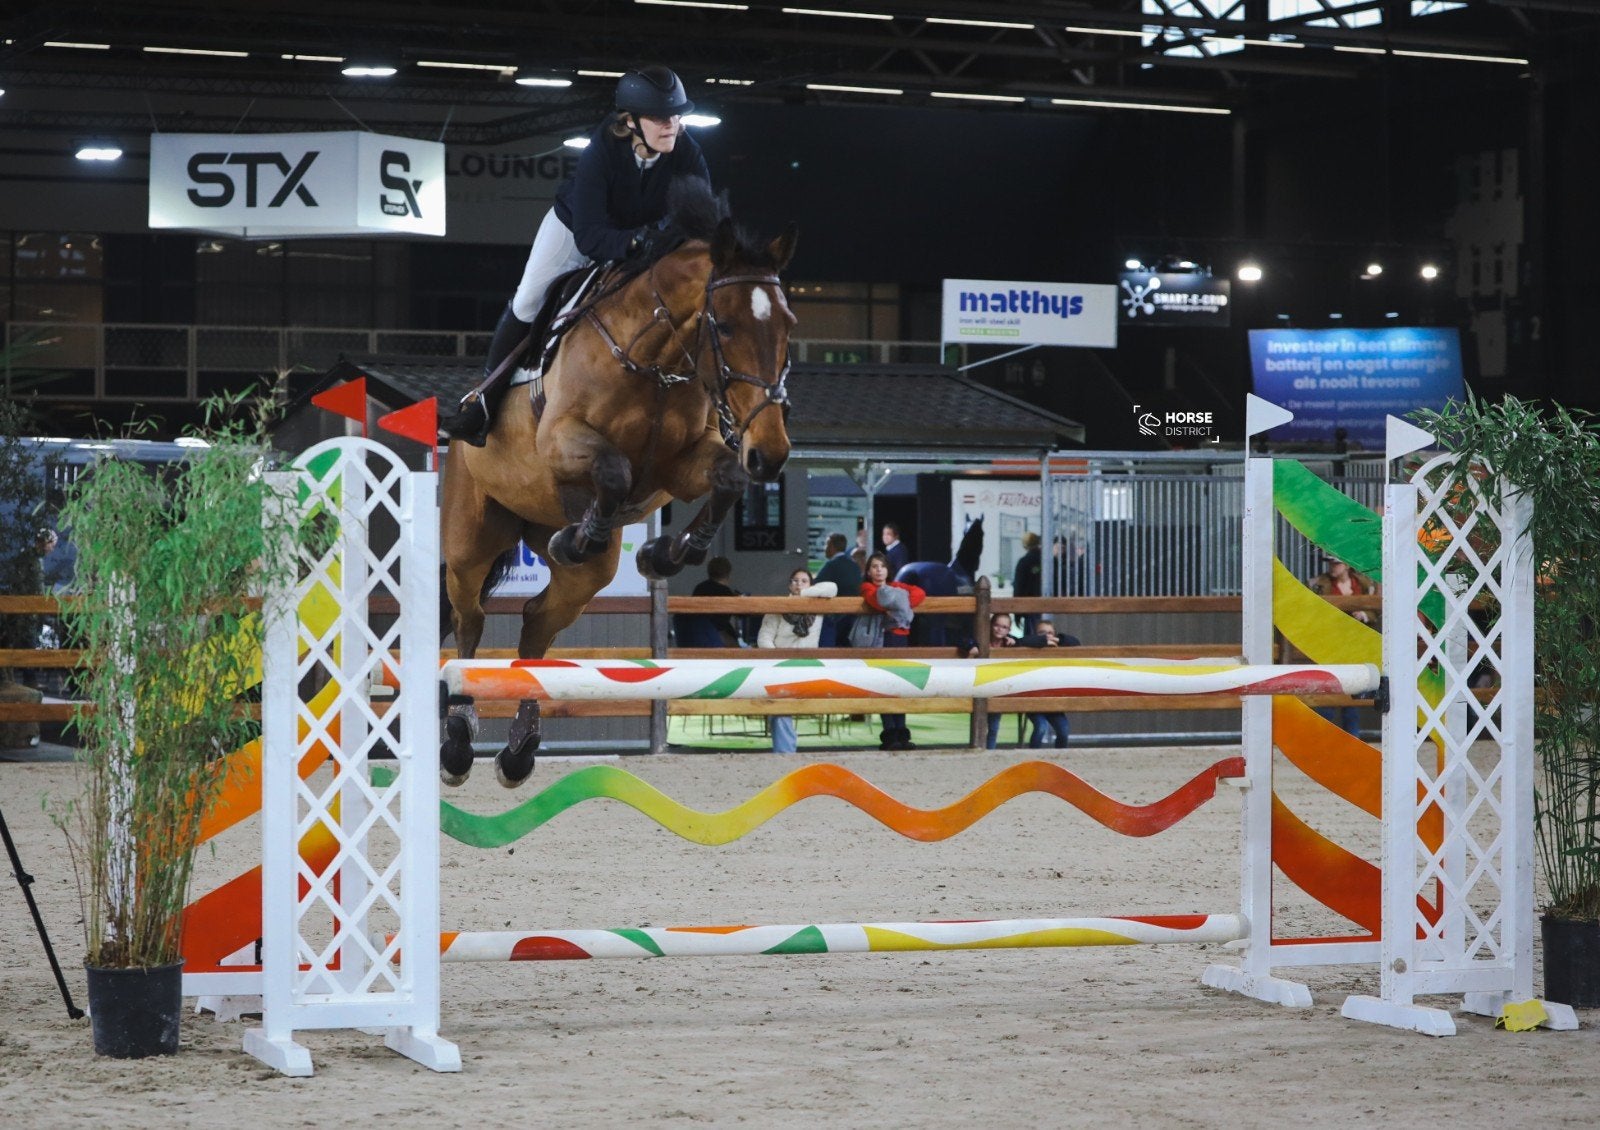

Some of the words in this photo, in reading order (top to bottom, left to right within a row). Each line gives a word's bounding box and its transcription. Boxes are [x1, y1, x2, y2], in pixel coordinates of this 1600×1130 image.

[446, 153, 579, 179] LOUNGE
[187, 151, 320, 207] STX
[960, 290, 1084, 318] matthys
[1267, 340, 1339, 353] Investeer
[1265, 357, 1322, 374] batterij
[1324, 359, 1343, 371] en
[1391, 357, 1450, 372] energie
[1294, 377, 1317, 389] als
[1320, 376, 1358, 389] nooit
[742, 530, 778, 547] STX
[520, 573, 538, 582] skill
